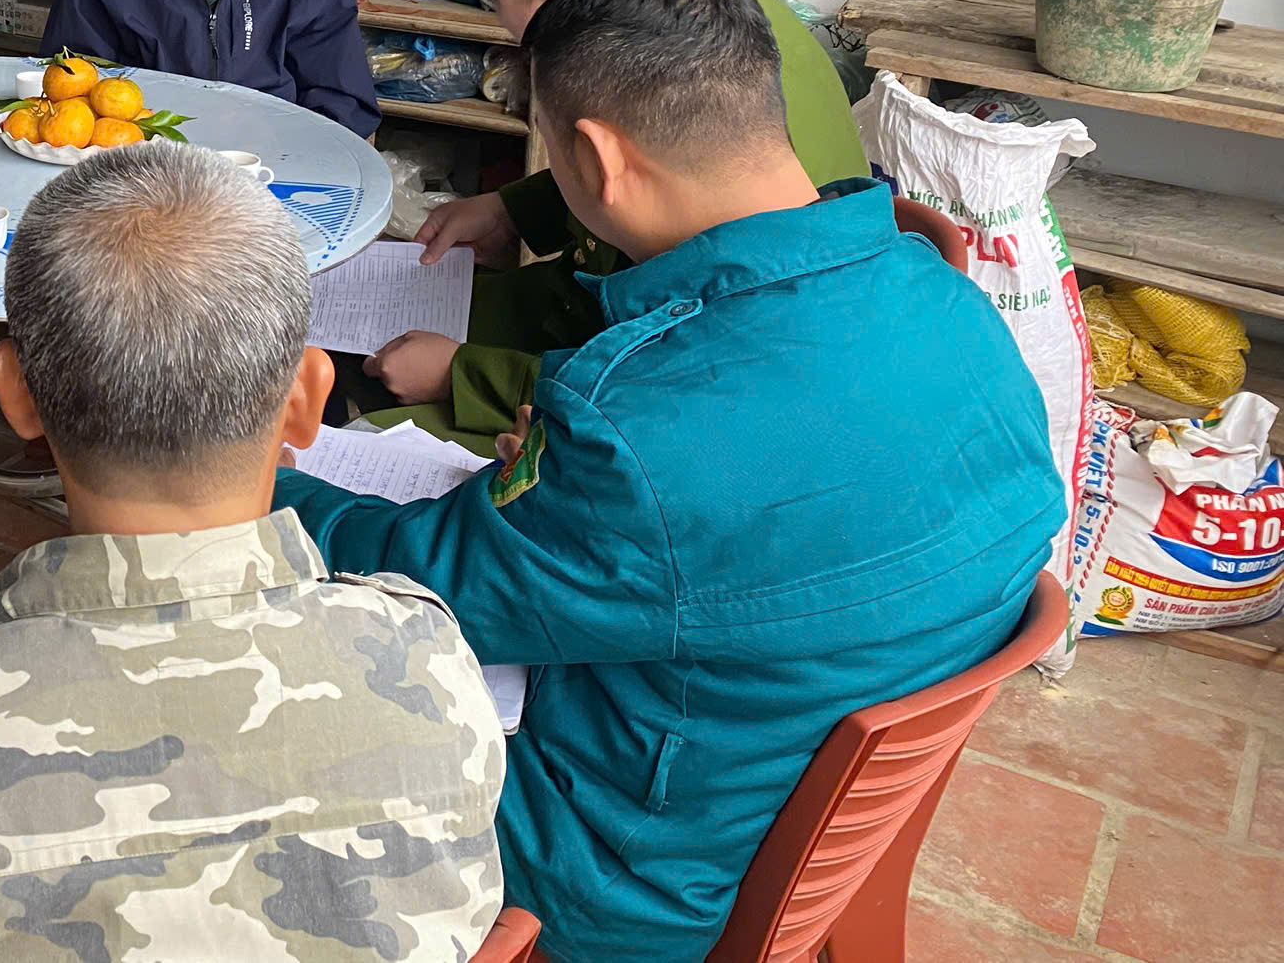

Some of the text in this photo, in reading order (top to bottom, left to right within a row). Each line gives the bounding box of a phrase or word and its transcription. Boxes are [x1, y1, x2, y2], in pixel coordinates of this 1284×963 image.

[1086, 450, 1109, 489] VIỆT
[1196, 493, 1267, 513] PHÂN
[1191, 510, 1284, 551] 5-10
[1212, 557, 1236, 574] ISO
[1144, 596, 1168, 612] SẢN
[1168, 600, 1199, 616] PHẨM
